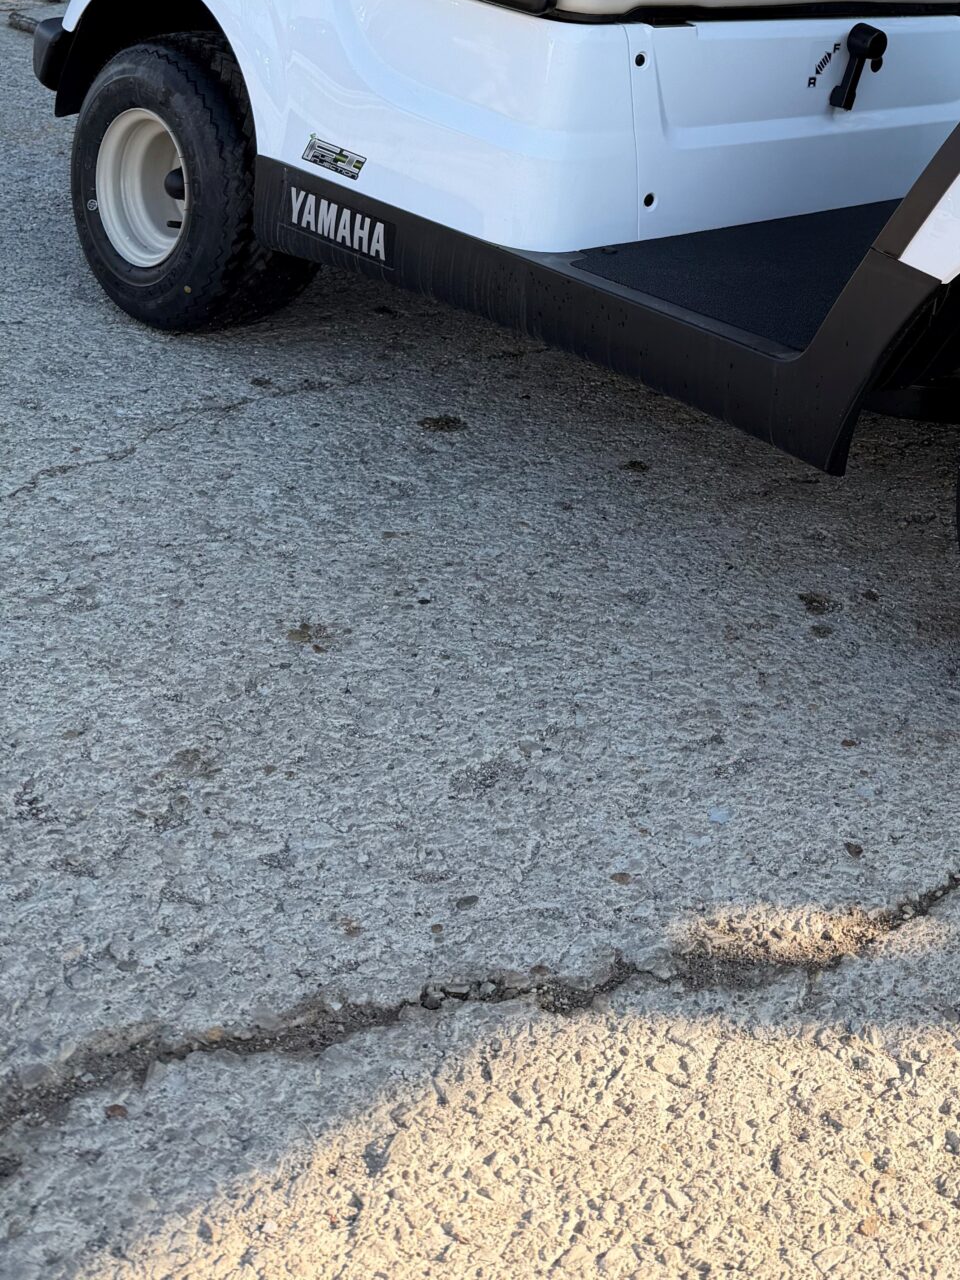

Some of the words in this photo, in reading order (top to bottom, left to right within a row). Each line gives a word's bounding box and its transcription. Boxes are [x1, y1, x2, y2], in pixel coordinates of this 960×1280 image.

[833, 43, 841, 53] F
[808, 76, 817, 88] R
[291, 186, 386, 261] YAMAHA
